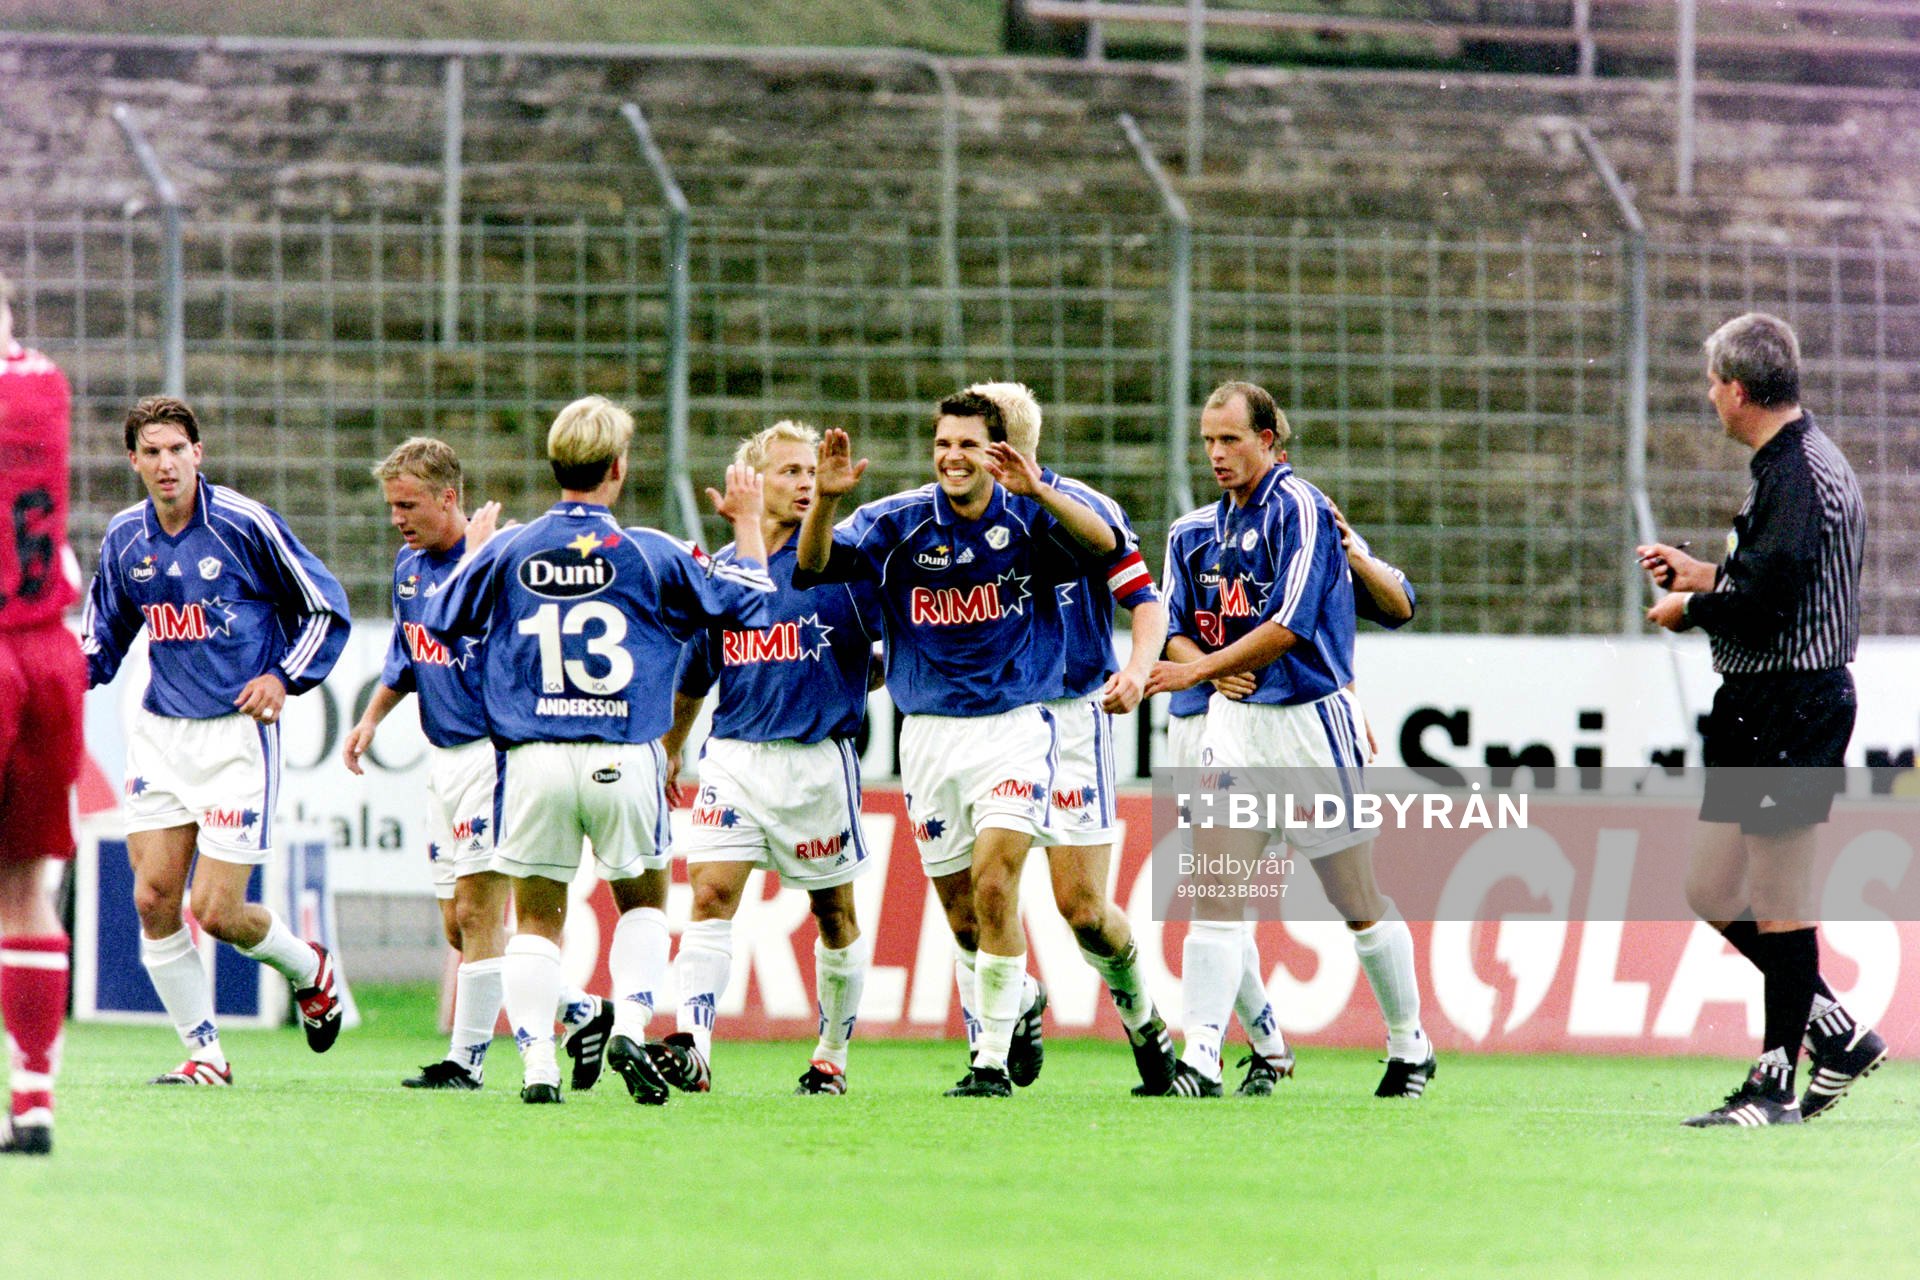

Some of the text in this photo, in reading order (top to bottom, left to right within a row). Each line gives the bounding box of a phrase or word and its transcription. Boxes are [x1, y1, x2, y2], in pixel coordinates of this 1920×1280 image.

[918, 553, 949, 566] Duni
[133, 565, 153, 578] Duni
[529, 558, 605, 586] Duni
[911, 582, 1000, 626] RIMI
[518, 601, 634, 695] 13
[723, 622, 798, 666] RIMI
[545, 682, 561, 691] ICA
[592, 682, 608, 691] ICA
[536, 698, 628, 717] ANDERSSON
[595, 768, 620, 781] Duni
[701, 785, 717, 804] 15
[203, 808, 241, 829] RIMI
[796, 836, 842, 860] RIMI
